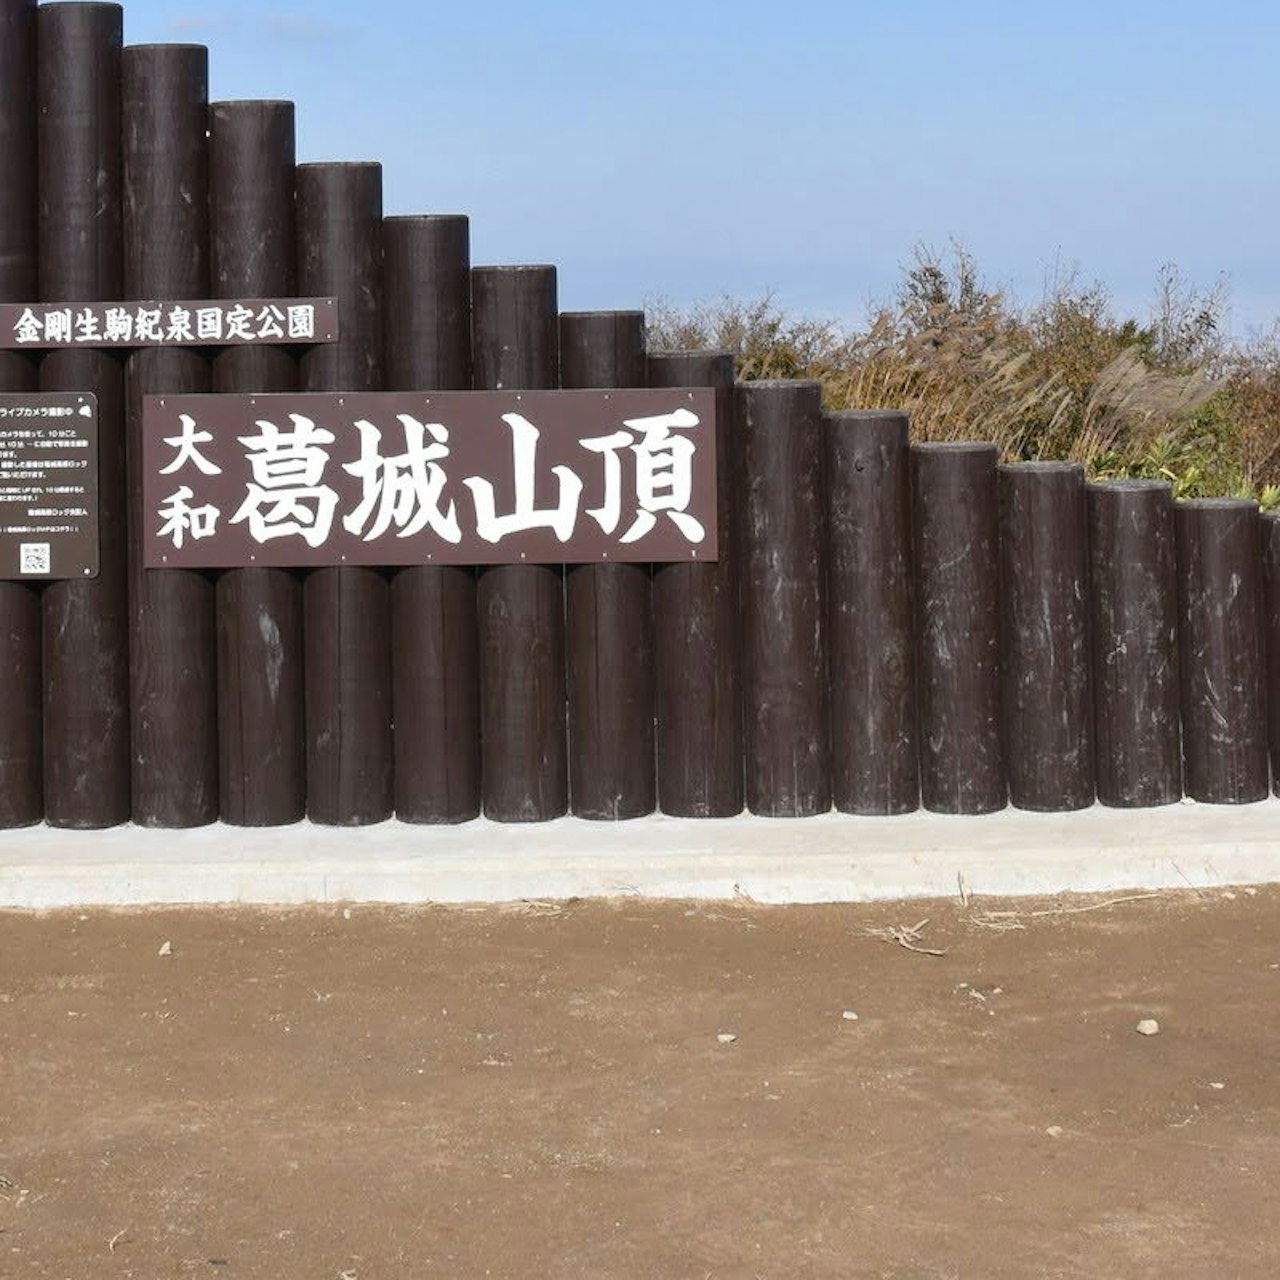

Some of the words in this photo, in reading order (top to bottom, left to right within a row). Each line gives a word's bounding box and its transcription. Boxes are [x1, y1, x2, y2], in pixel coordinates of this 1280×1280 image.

[13, 304, 316, 343] 金剛生駒紀泉国定公園
[156, 414, 222, 549] 大和
[229, 407, 705, 548] 葛城山頂
